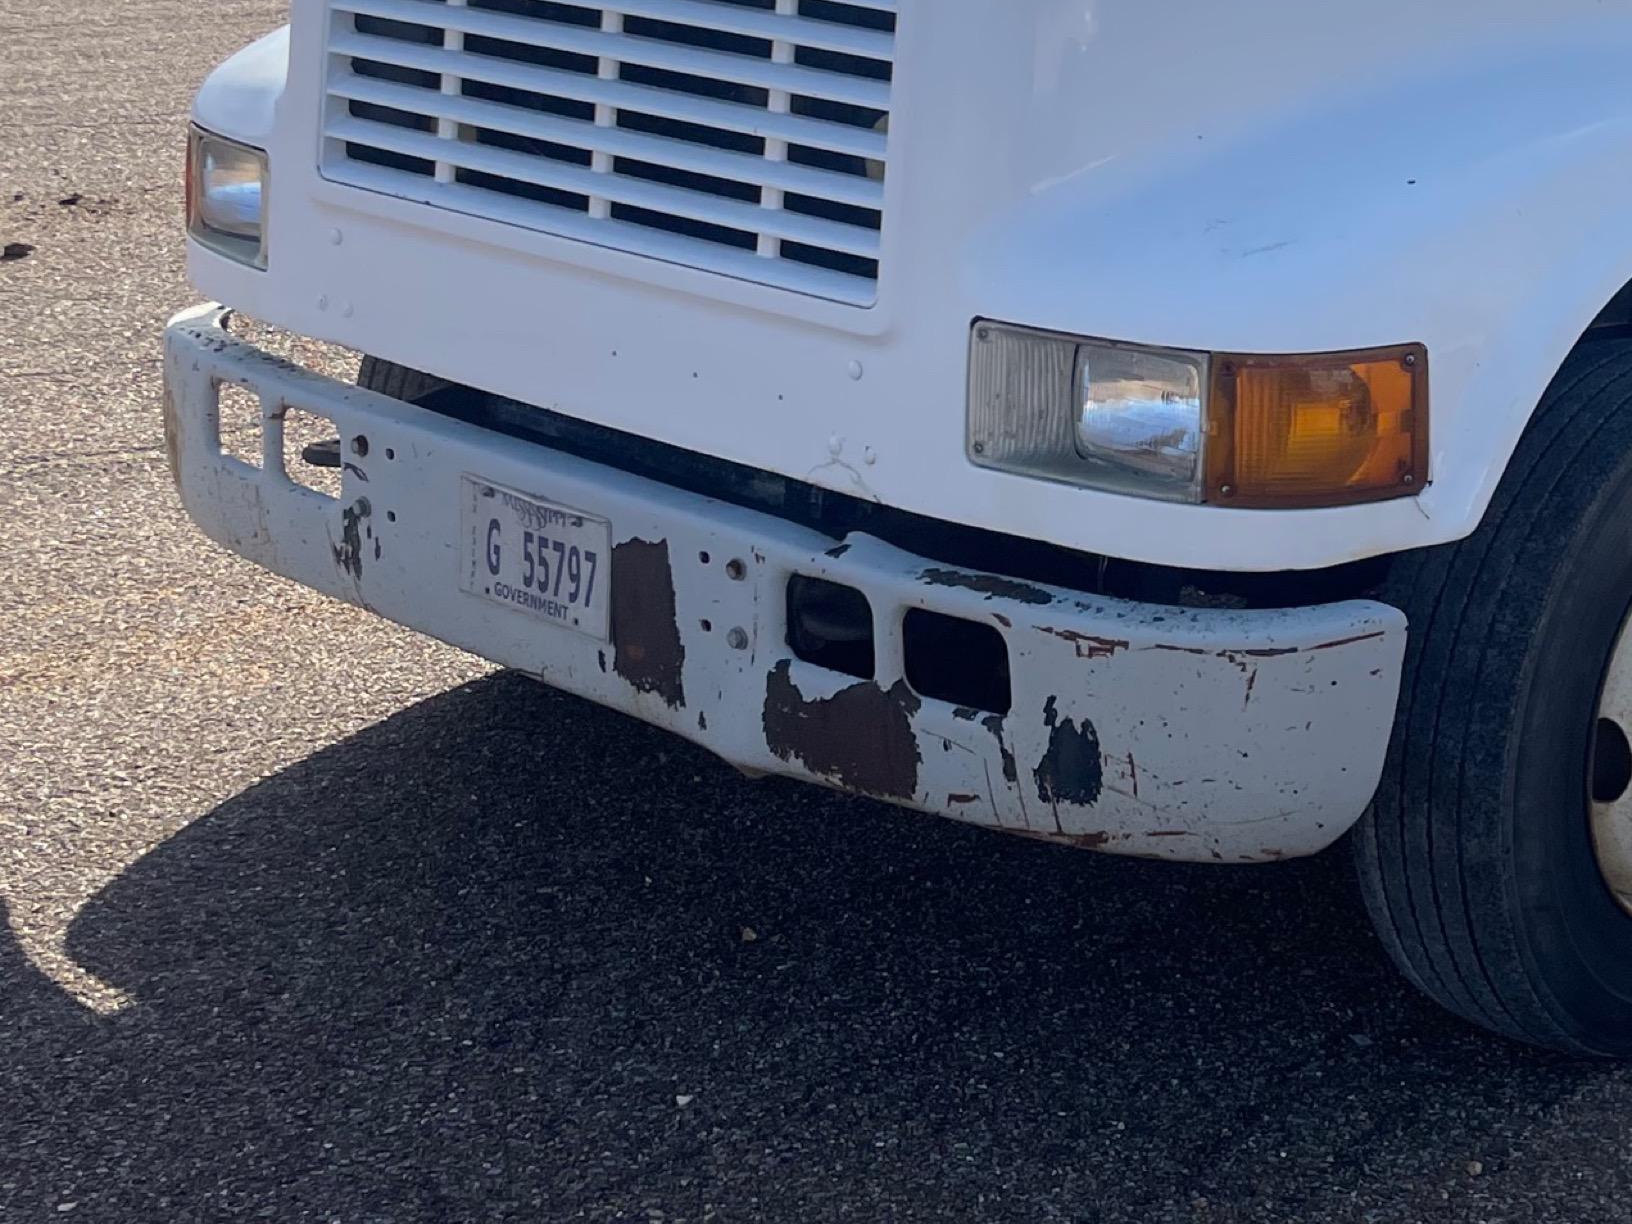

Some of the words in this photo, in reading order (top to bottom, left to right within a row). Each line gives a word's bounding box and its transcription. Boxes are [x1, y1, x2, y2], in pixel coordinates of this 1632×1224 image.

[486, 518, 501, 576] G
[522, 531, 598, 609] 55797
[494, 581, 569, 621] GOVERNMENT
